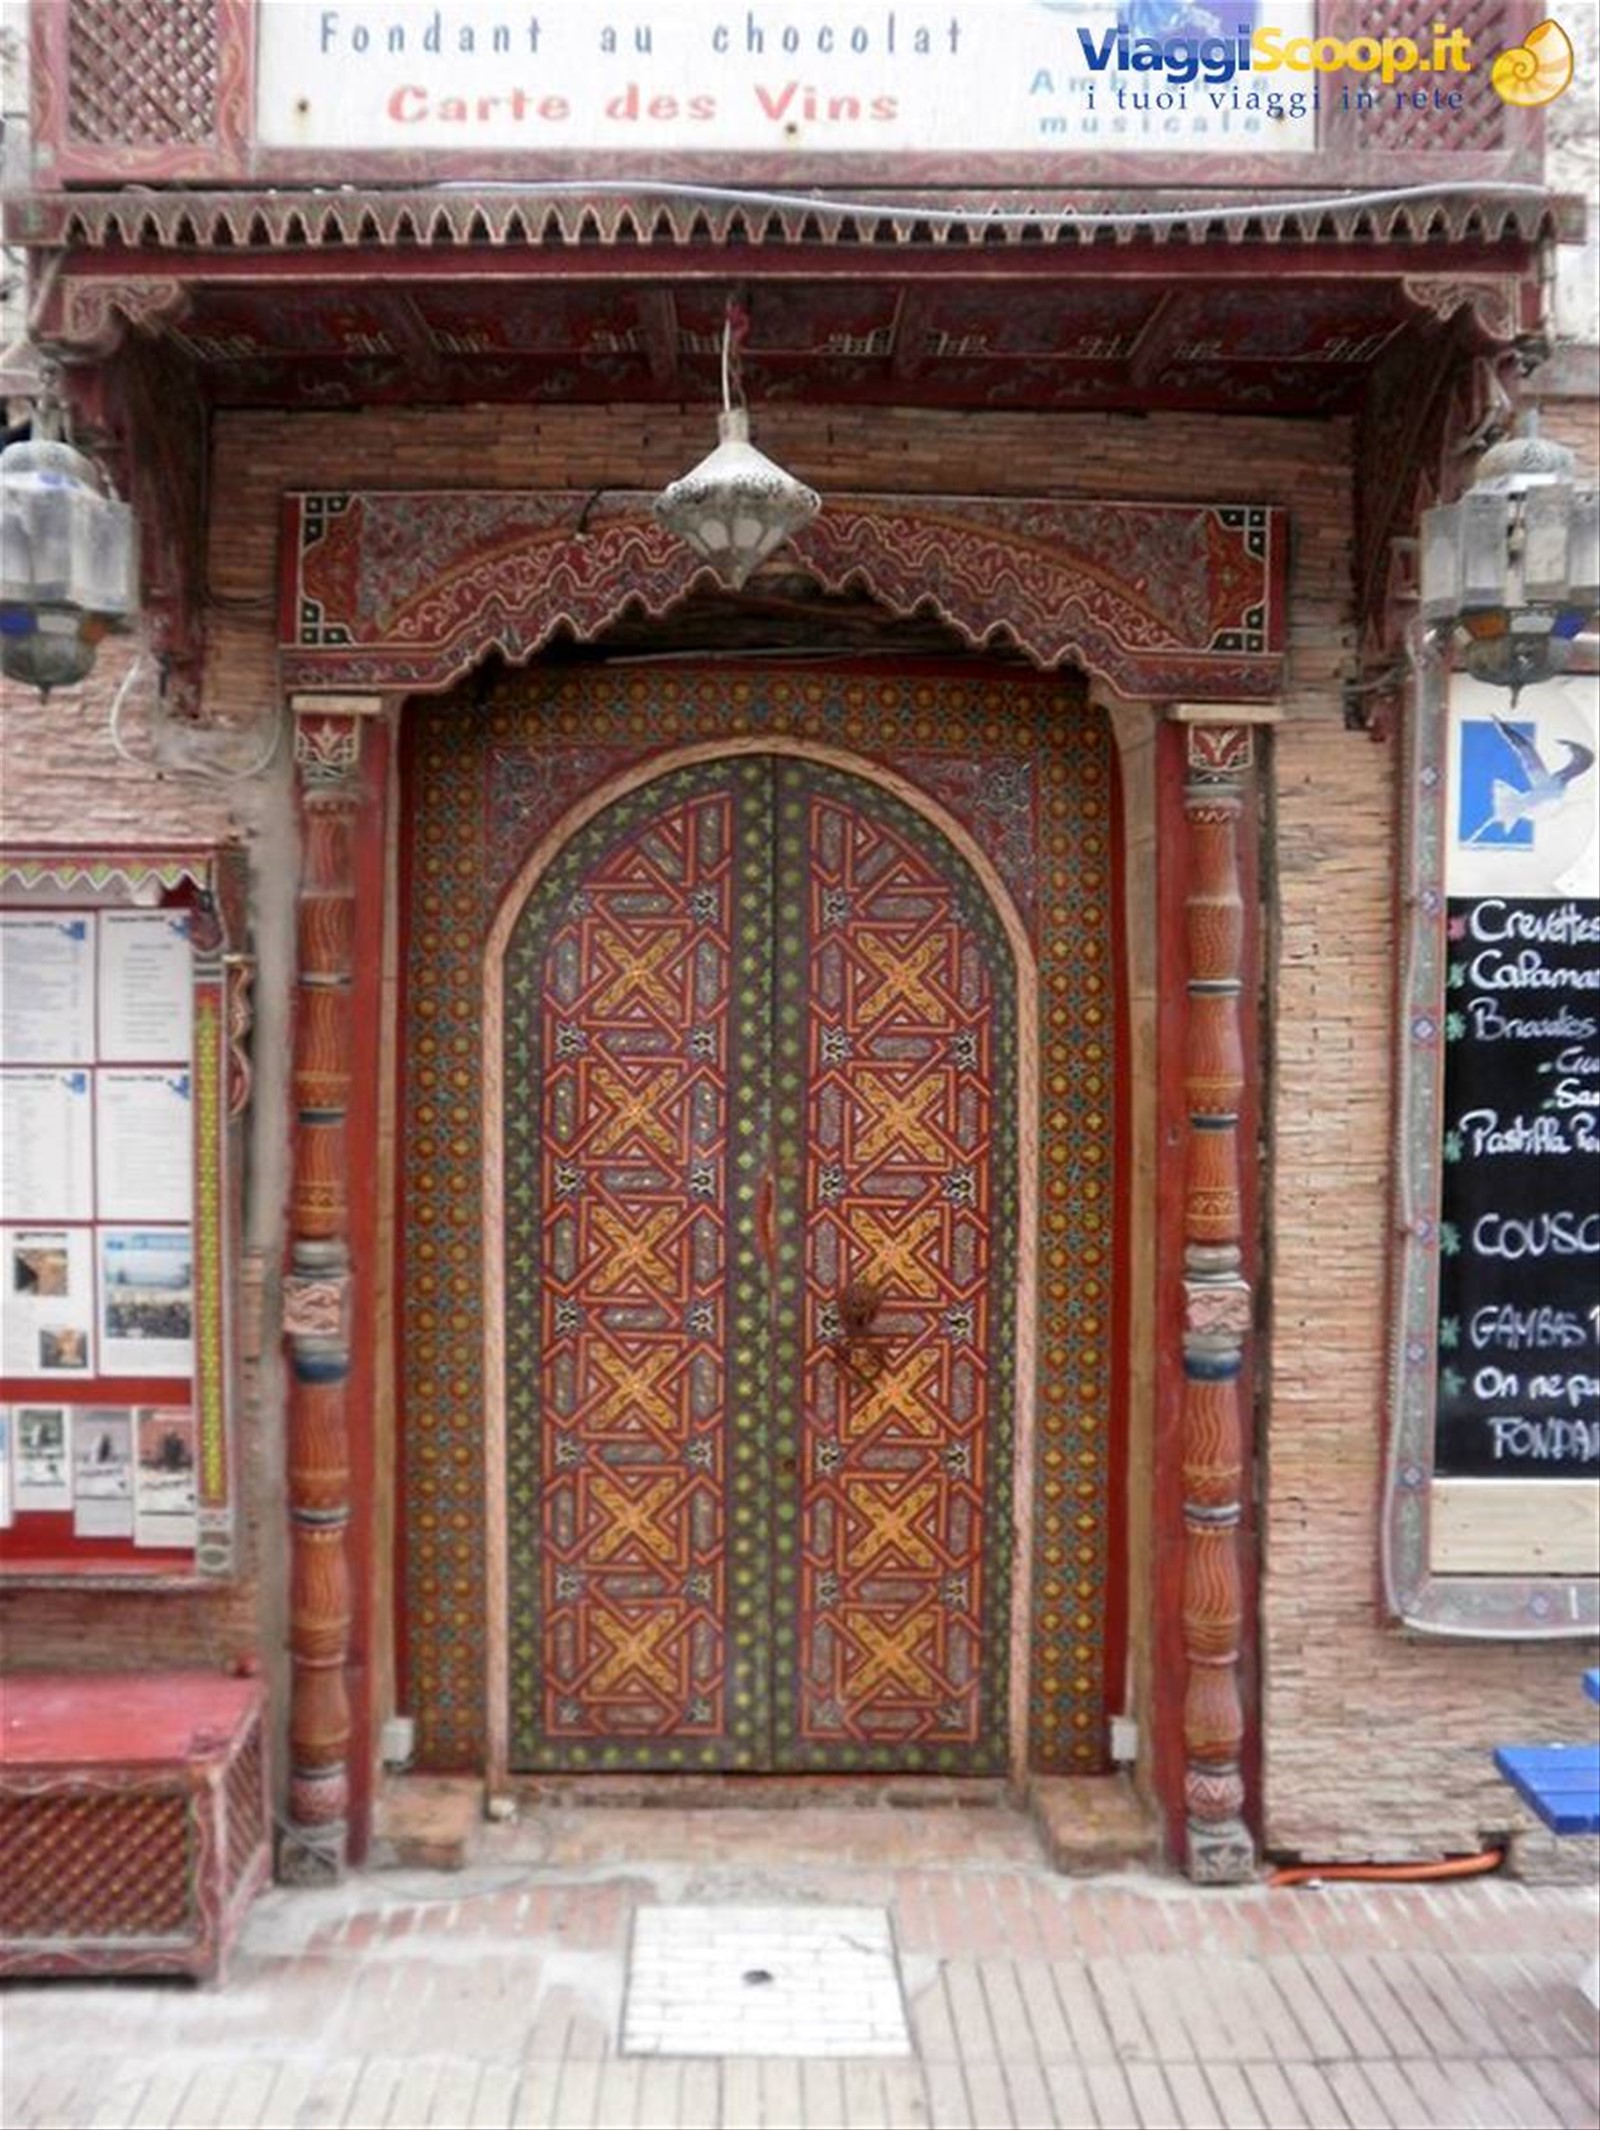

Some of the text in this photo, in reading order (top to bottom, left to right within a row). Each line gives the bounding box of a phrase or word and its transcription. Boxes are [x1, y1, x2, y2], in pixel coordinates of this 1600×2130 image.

[319, 11, 961, 54] Fondant au chocolat
[387, 81, 899, 123] Carte des Vins
[1039, 112, 1262, 134] musicale
[1474, 1366, 1518, 1399] On
